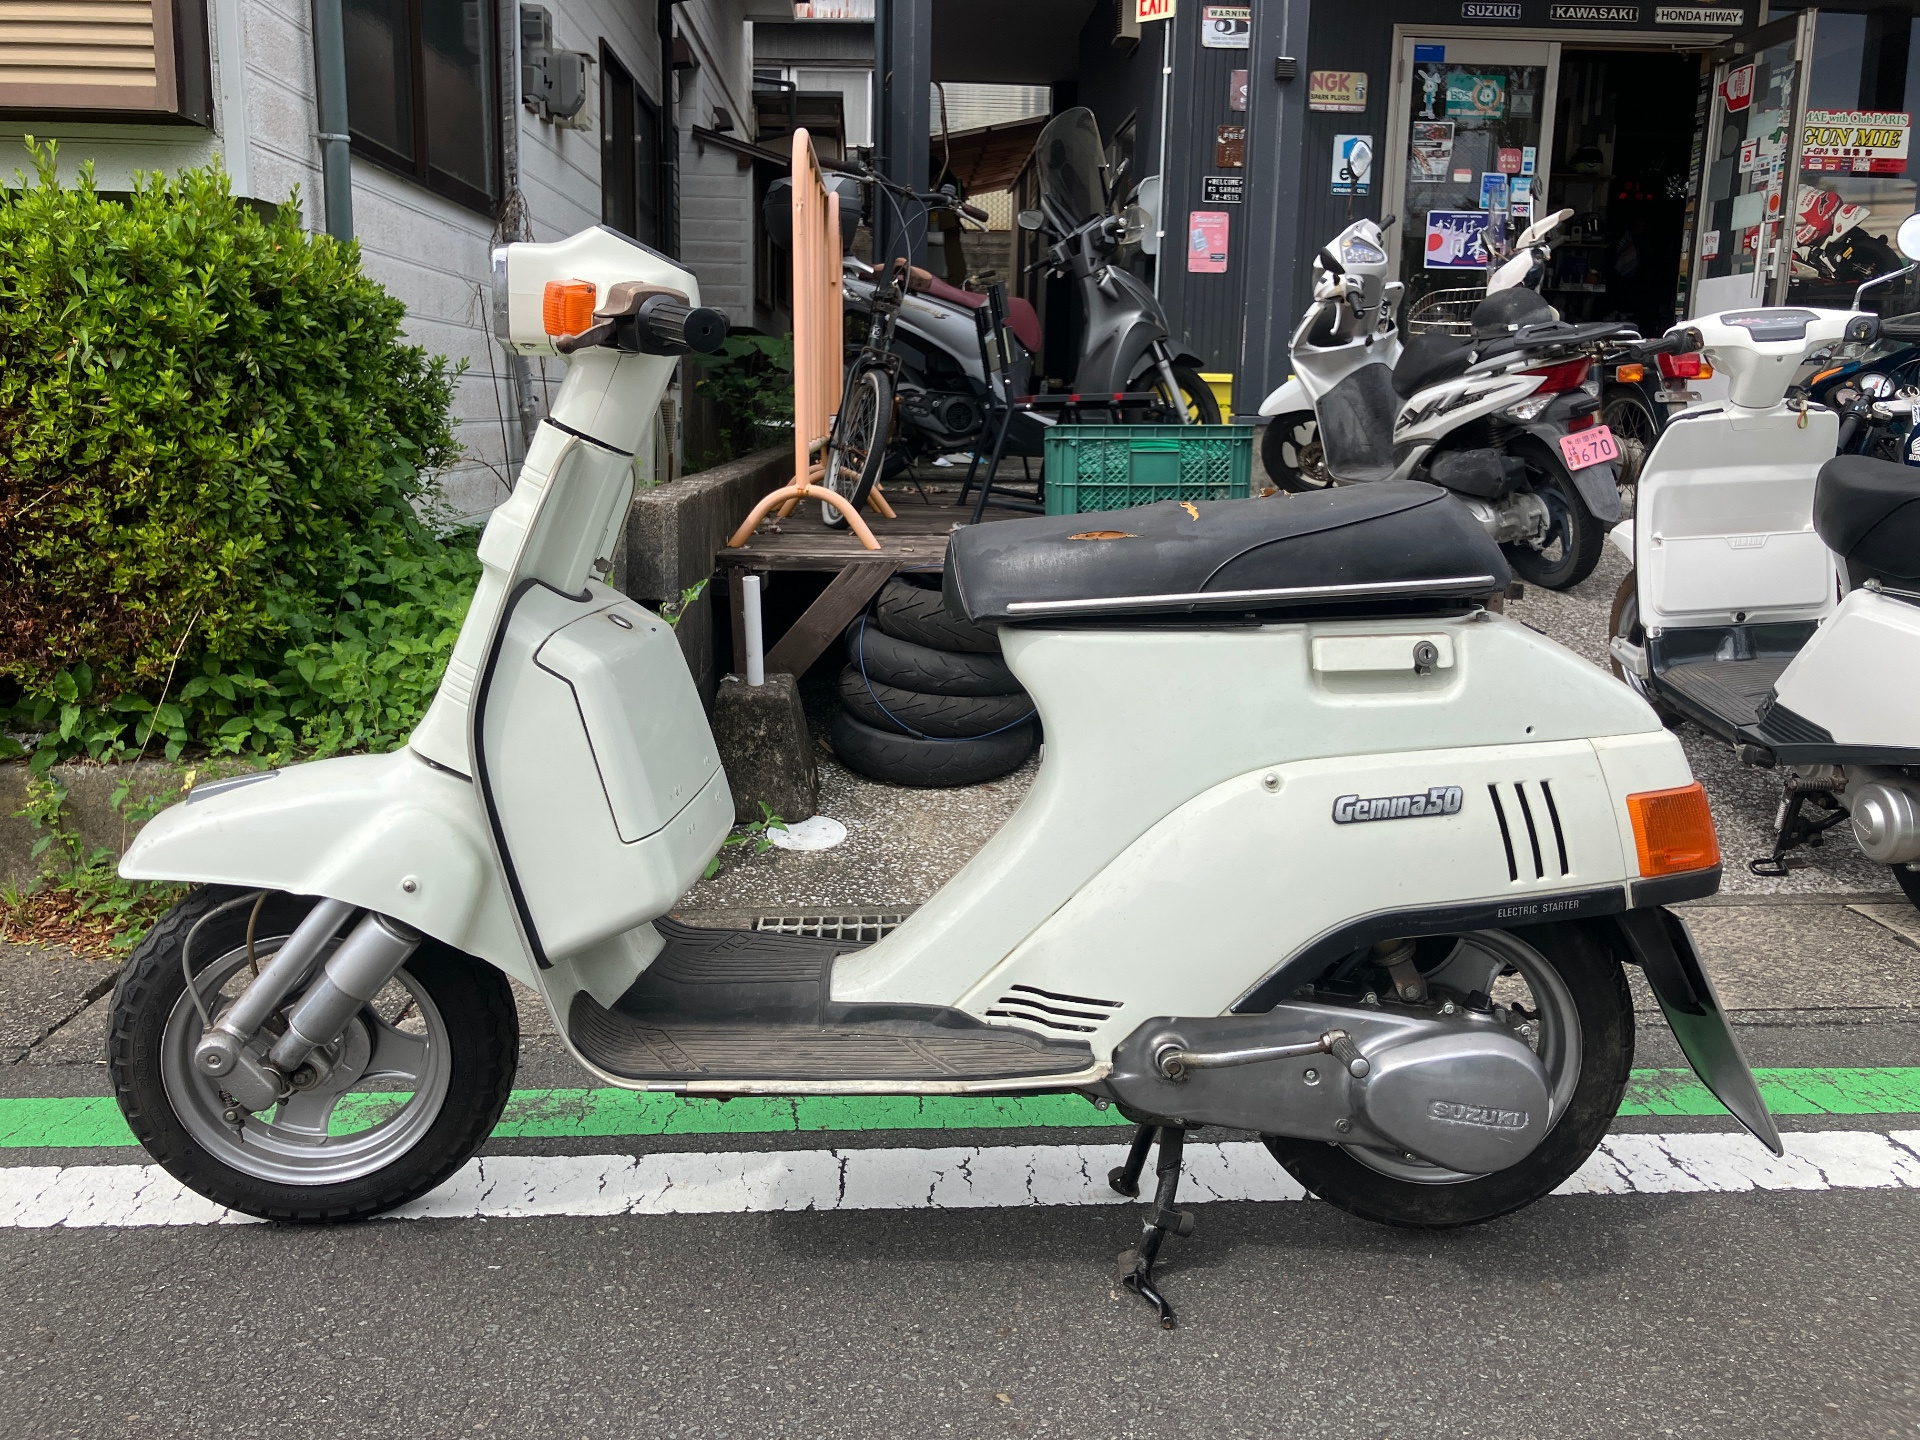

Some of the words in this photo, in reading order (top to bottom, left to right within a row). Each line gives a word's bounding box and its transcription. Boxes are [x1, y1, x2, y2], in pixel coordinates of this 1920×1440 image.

[1140, 0, 1169, 17] EXIT
[1468, 5, 1516, 17] SUZUKI
[1556, 8, 1633, 20] KAWASAKI
[1661, 10, 1701, 22] HONDA
[1704, 11, 1739, 22] HIWAY
[1311, 72, 1351, 93] NGK
[1829, 113, 1848, 123] with
[1850, 113, 1873, 123] Club
[1874, 114, 1908, 125] PARIS
[1852, 128, 1903, 148] MIE
[1219, 186, 1243, 194] GARAGE
[1450, 232, 1488, 259] 日本
[1581, 439, 1612, 462] 670
[1335, 787, 1462, 822] Gemma50
[1497, 904, 1538, 918] ELECTRIC
[1542, 899, 1579, 913] STARTER
[1433, 1101, 1521, 1126] SUZUKI
